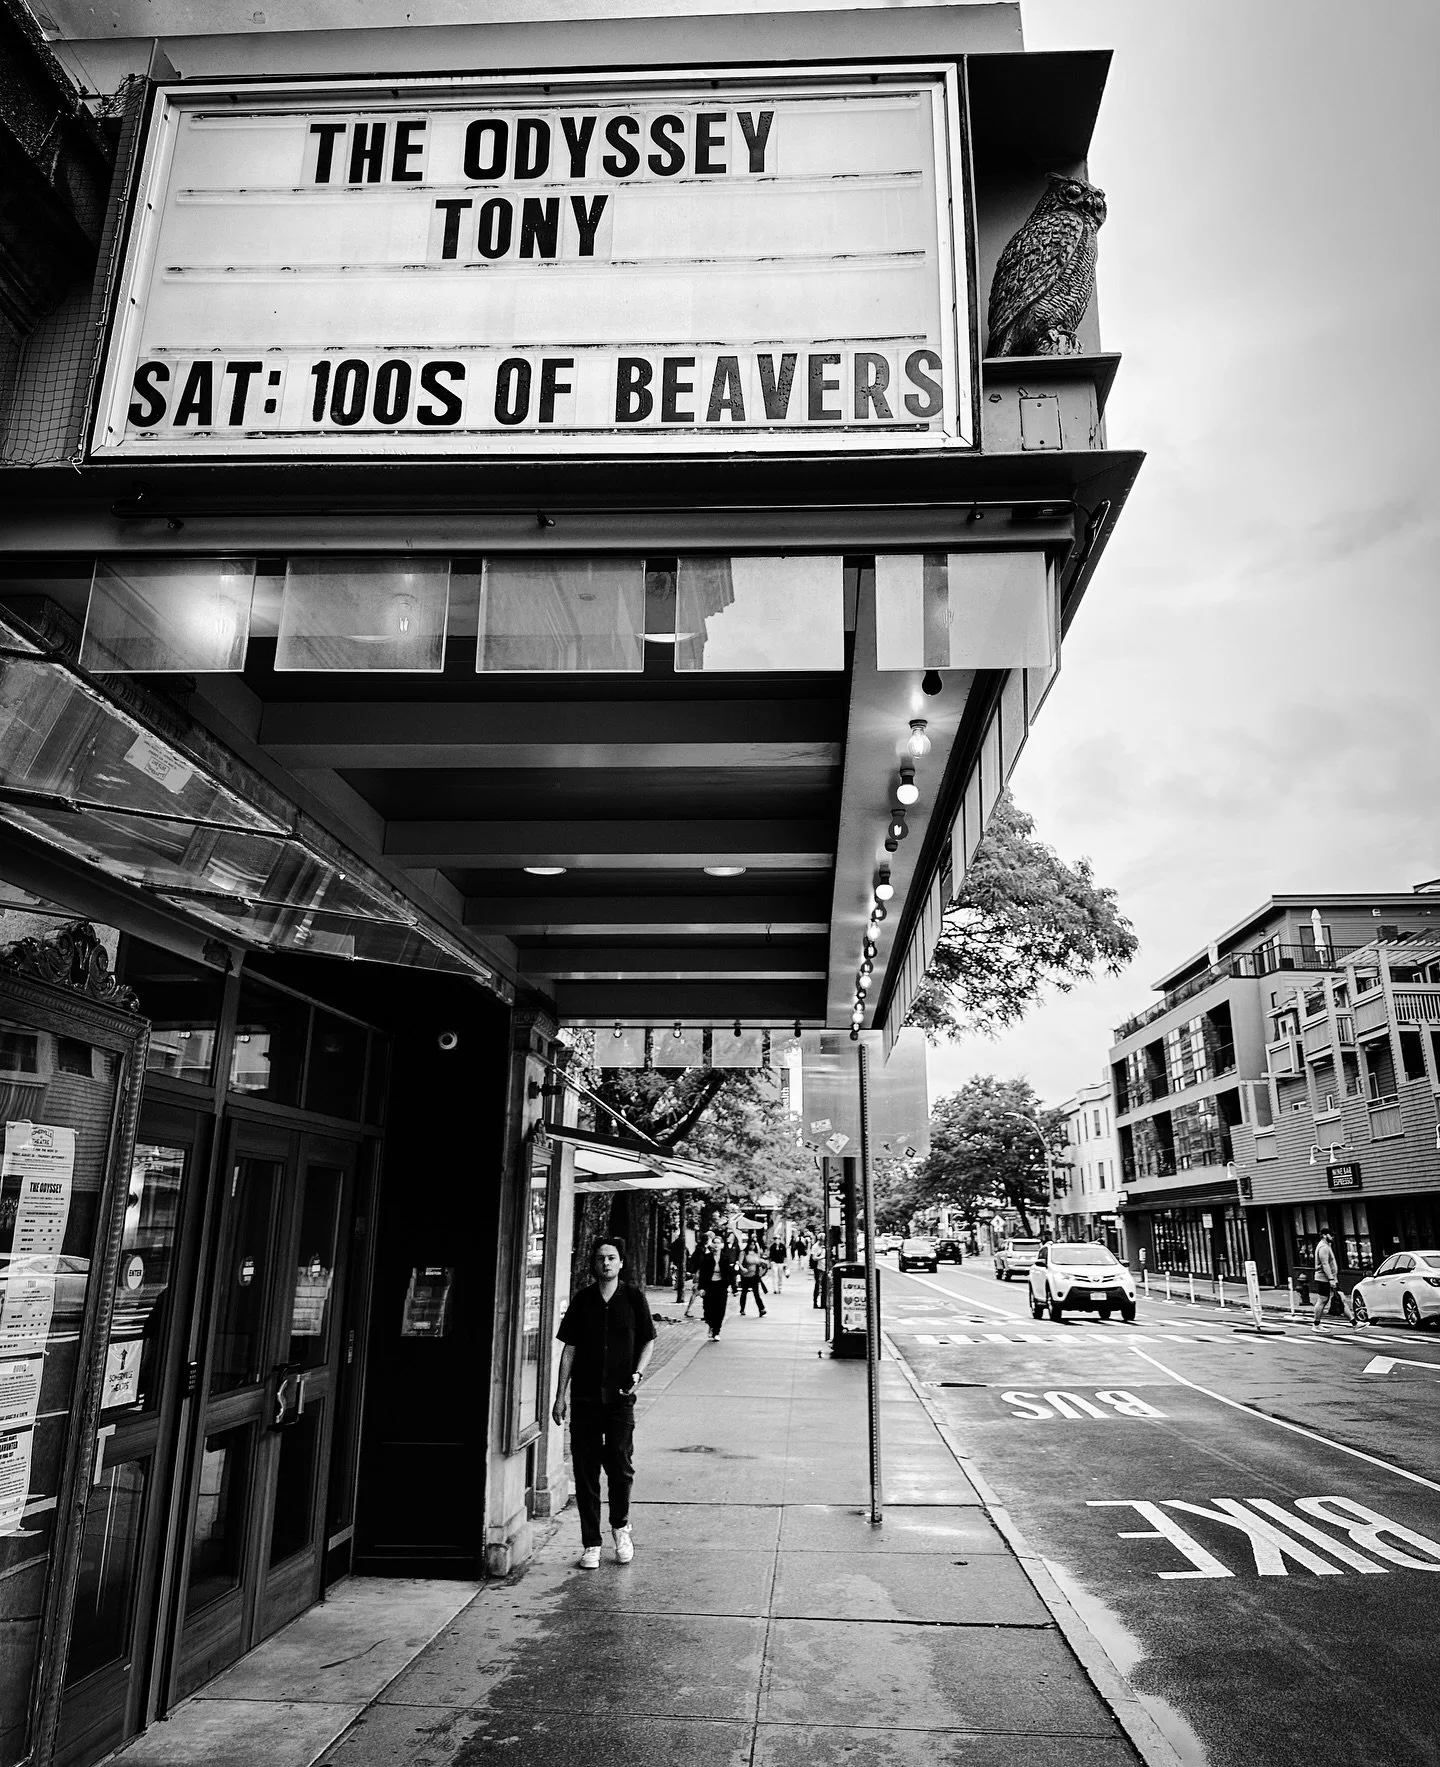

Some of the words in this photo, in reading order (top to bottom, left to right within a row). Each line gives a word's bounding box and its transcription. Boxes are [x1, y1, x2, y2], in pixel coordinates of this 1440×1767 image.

[309, 121, 427, 184] THE
[463, 110, 775, 181] ODYSSEY
[435, 194, 609, 260] TONY
[130, 360, 282, 428] SAT:
[310, 358, 466, 427] 100S
[494, 357, 575, 426] OF
[614, 348, 944, 424] BEAVERS
[29, 1182, 40, 1193] THE
[39, 1183, 63, 1194] ODYSSEY
[128, 1269, 143, 1277] ENTER
[1000, 1390, 1170, 1420] BUS
[1085, 1494, 1440, 1580] BIKE
